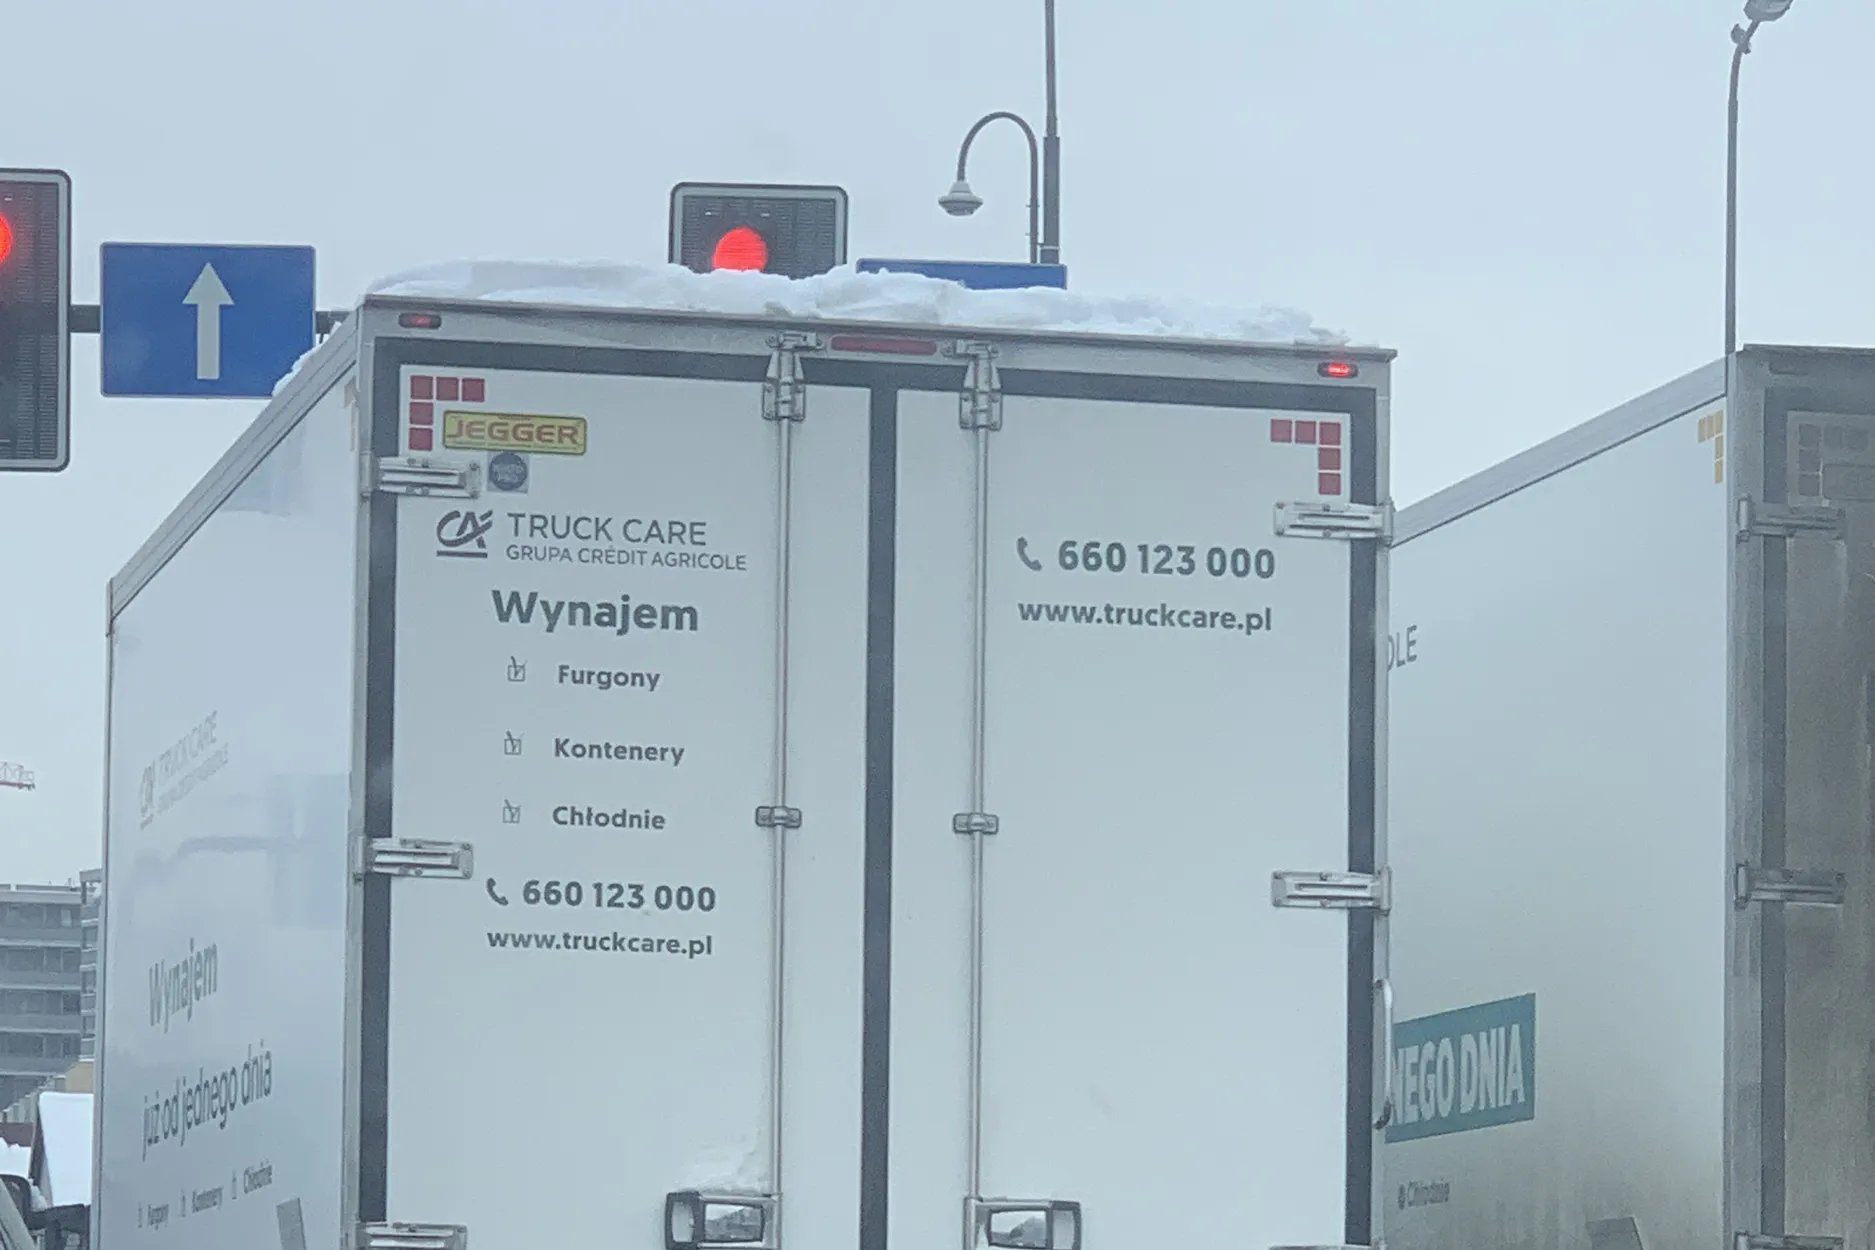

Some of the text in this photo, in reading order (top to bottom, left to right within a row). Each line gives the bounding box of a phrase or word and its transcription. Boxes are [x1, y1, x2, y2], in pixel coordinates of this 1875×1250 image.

[446, 419, 580, 445] JEGGER
[507, 512, 707, 547] TRUCK CARE
[506, 543, 573, 563] GRUPA
[651, 549, 747, 571] AGRICOLE
[1058, 540, 1275, 580] 660 123 000
[492, 589, 699, 636] Wynajem
[1018, 602, 1272, 636] www.truckcare.pl
[558, 664, 661, 692] Furgony
[554, 738, 685, 767] Kontenery
[552, 806, 666, 830] Chłodnie
[523, 879, 716, 913] 660 123 000
[487, 932, 712, 959] www.truckcare.pl
[149, 937, 217, 1034] Wynajem
[1460, 1023, 1525, 1115] DNIA
[180, 1067, 238, 1146] jednego
[241, 1038, 272, 1106] dnia
